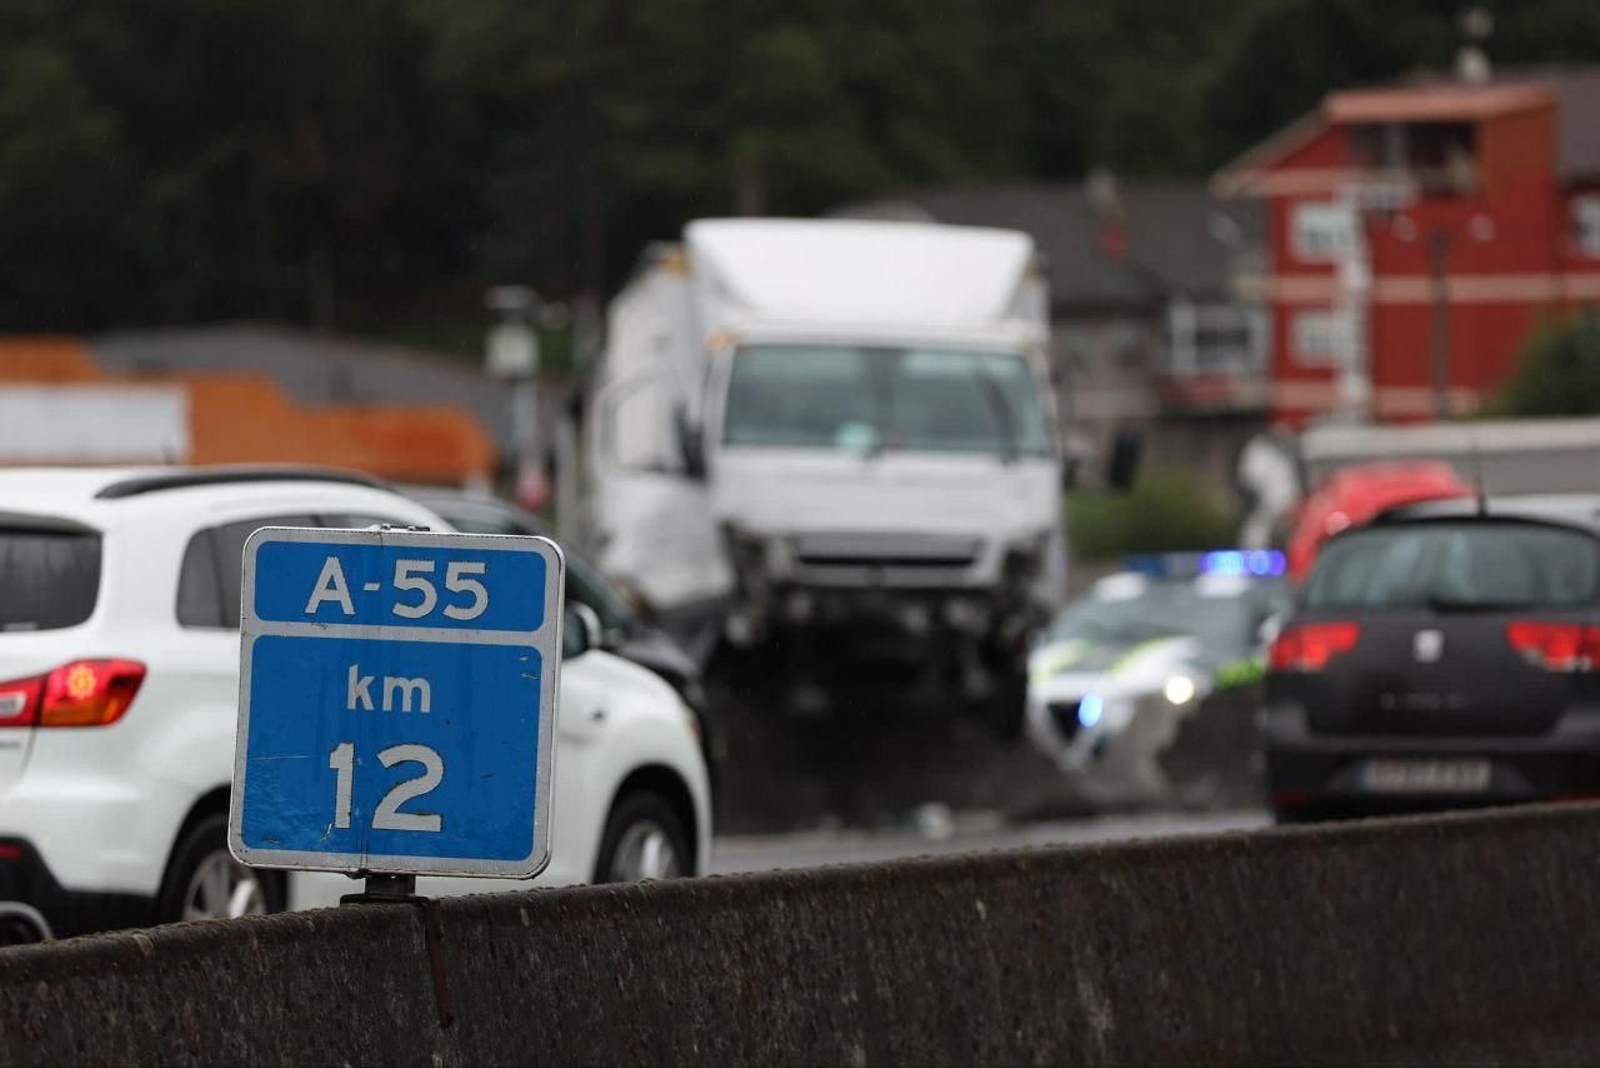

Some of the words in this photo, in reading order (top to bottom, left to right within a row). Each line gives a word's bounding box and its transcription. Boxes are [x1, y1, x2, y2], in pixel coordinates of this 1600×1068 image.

[304, 556, 489, 620] A-55
[347, 664, 431, 713] km
[329, 743, 444, 832] 12
